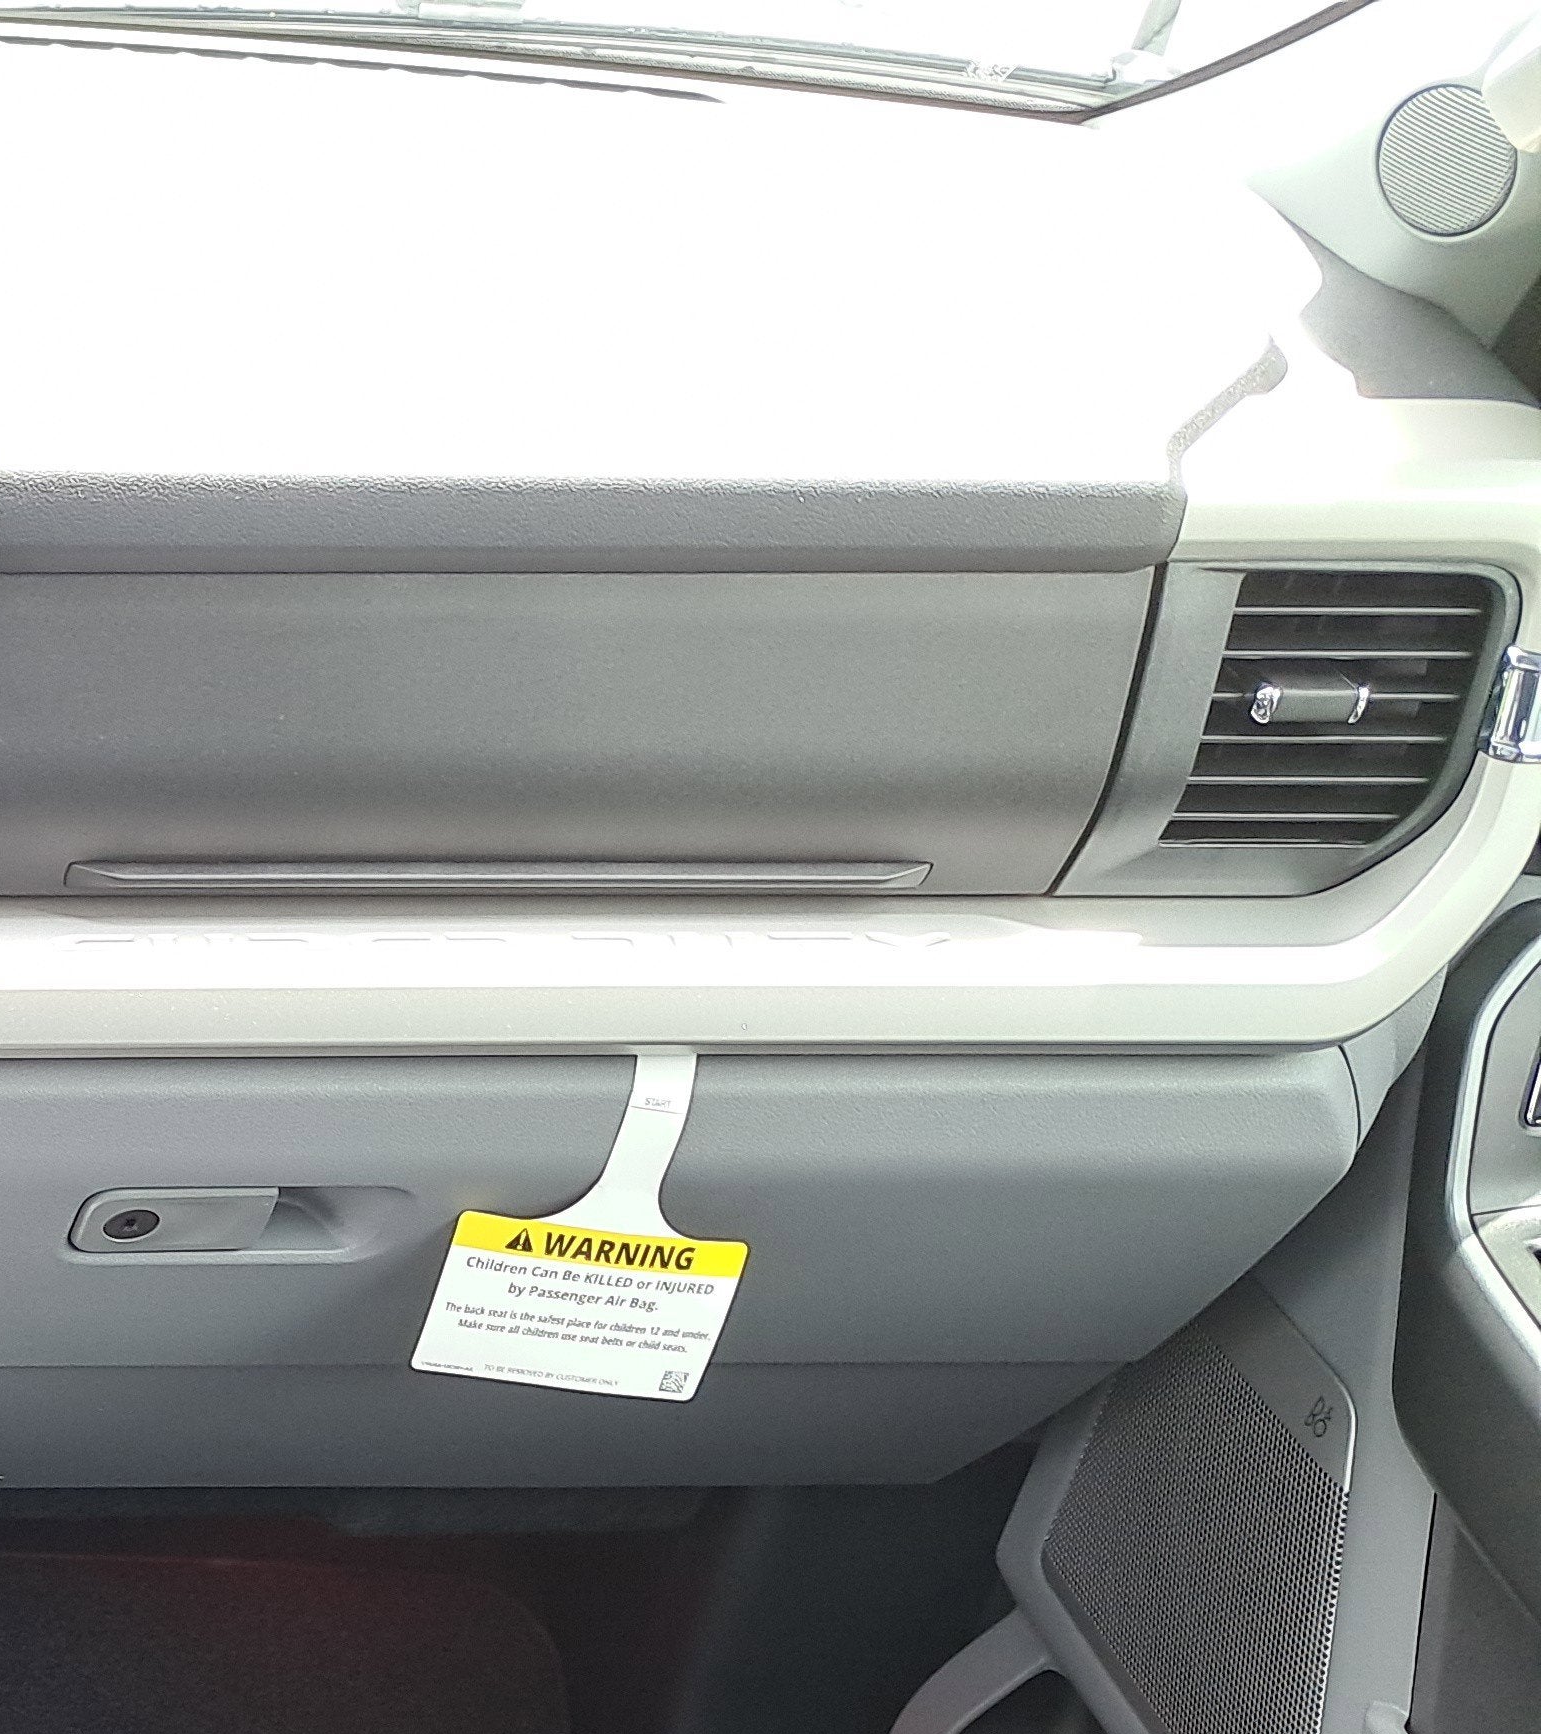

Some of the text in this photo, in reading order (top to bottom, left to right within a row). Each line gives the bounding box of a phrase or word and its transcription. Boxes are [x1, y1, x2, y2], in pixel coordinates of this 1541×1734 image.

[544, 1231, 696, 1271] WARNING
[466, 1256, 715, 1295] Children Can Be KILLED or INJURED
[508, 1282, 659, 1313] by Passenger Air Bag.
[445, 1301, 462, 1313] The
[464, 1304, 485, 1315] back
[488, 1307, 508, 1318] seat
[509, 1309, 518, 1319] is
[520, 1310, 535, 1321] the
[537, 1314, 565, 1326] safest
[566, 1318, 591, 1330] place
[609, 1321, 646, 1335] children
[458, 1318, 482, 1330] Make
[508, 1324, 519, 1334] all
[522, 1325, 559, 1340] children
